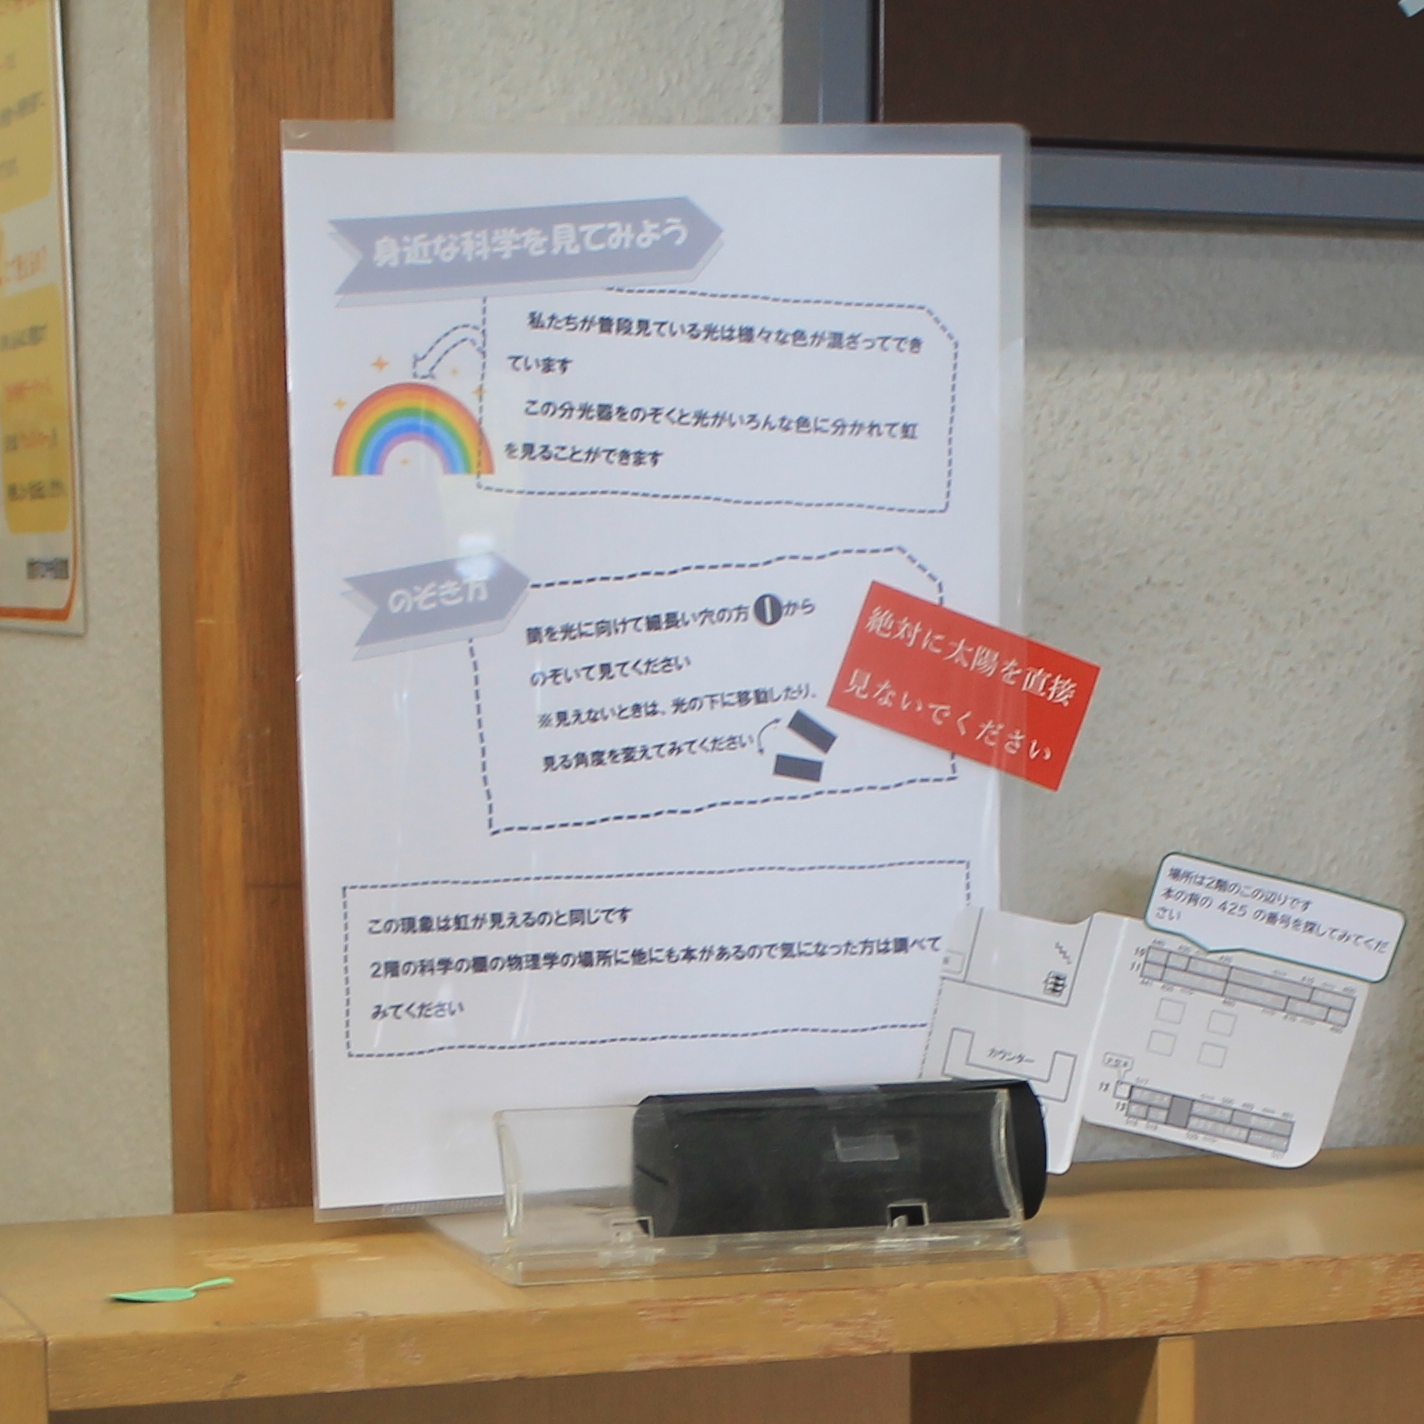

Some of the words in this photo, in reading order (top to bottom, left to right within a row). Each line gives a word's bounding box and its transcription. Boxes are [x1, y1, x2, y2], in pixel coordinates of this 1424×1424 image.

[373, 218, 688, 268] 身近な科学を見てみよう
[507, 354, 572, 375] ています
[523, 399, 918, 440] この分光器をのぞくと光がいろんな色に分かれて虹
[504, 442, 664, 467] を見ることができます
[387, 577, 490, 613] のぞき方
[530, 653, 692, 689] のぞいて見てください
[864, 606, 1078, 707] 絶対に太陽を直接
[845, 668, 1053, 761] 見ないでください
[542, 733, 755, 773] 見る角度を変えてみてください
[367, 906, 633, 936] この現象は虹が見えるのと同じです
[1155, 905, 1182, 921] さい
[1217, 900, 1247, 918] 425
[371, 1000, 465, 1022] みてください
[987, 1046, 1035, 1065] カウンター
